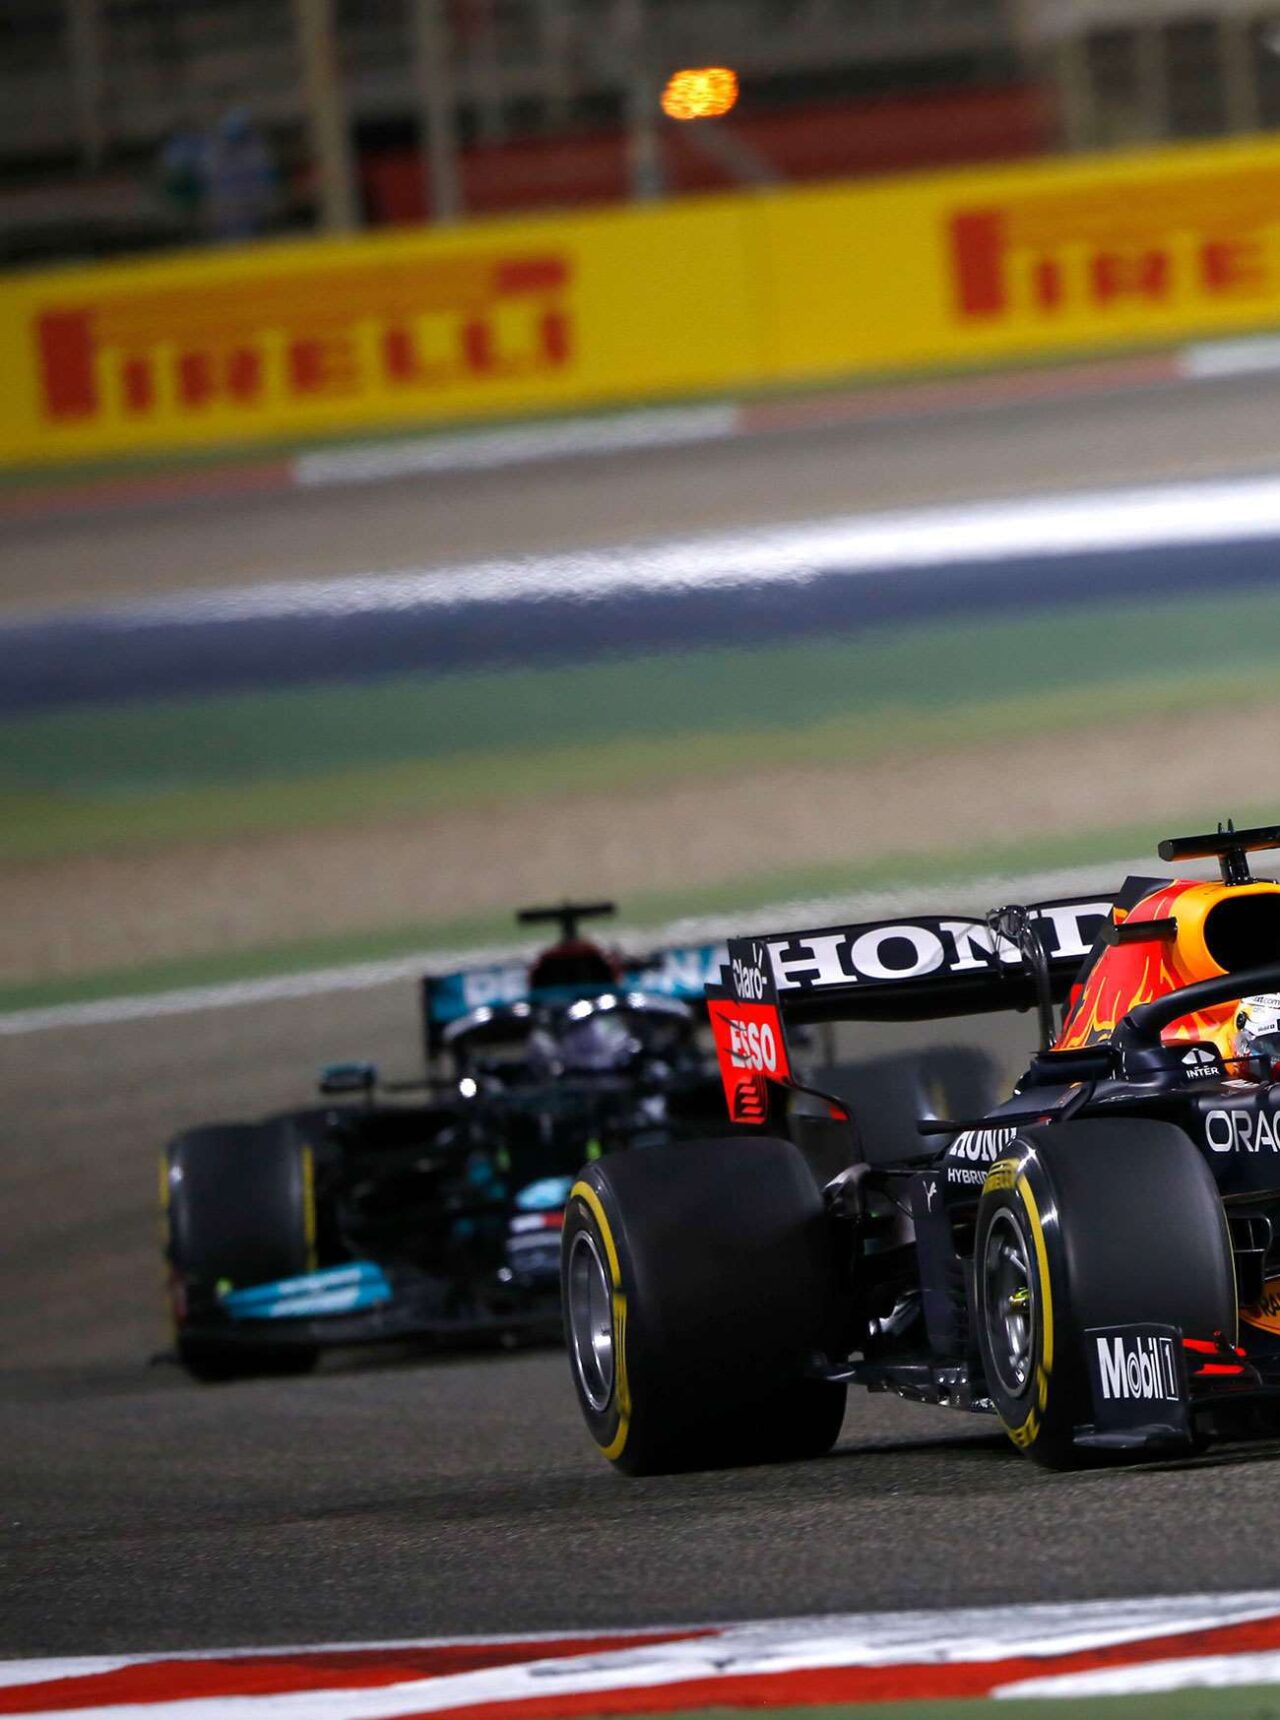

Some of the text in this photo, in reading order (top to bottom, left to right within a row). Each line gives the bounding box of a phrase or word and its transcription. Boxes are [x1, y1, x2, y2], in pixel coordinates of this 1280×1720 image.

[34, 250, 571, 422] PIRELLI
[732, 952, 765, 1000] Claro
[766, 902, 1114, 990] HOND
[1186, 1066, 1220, 1079] INTER
[1096, 1337, 1163, 1399] Mobil
